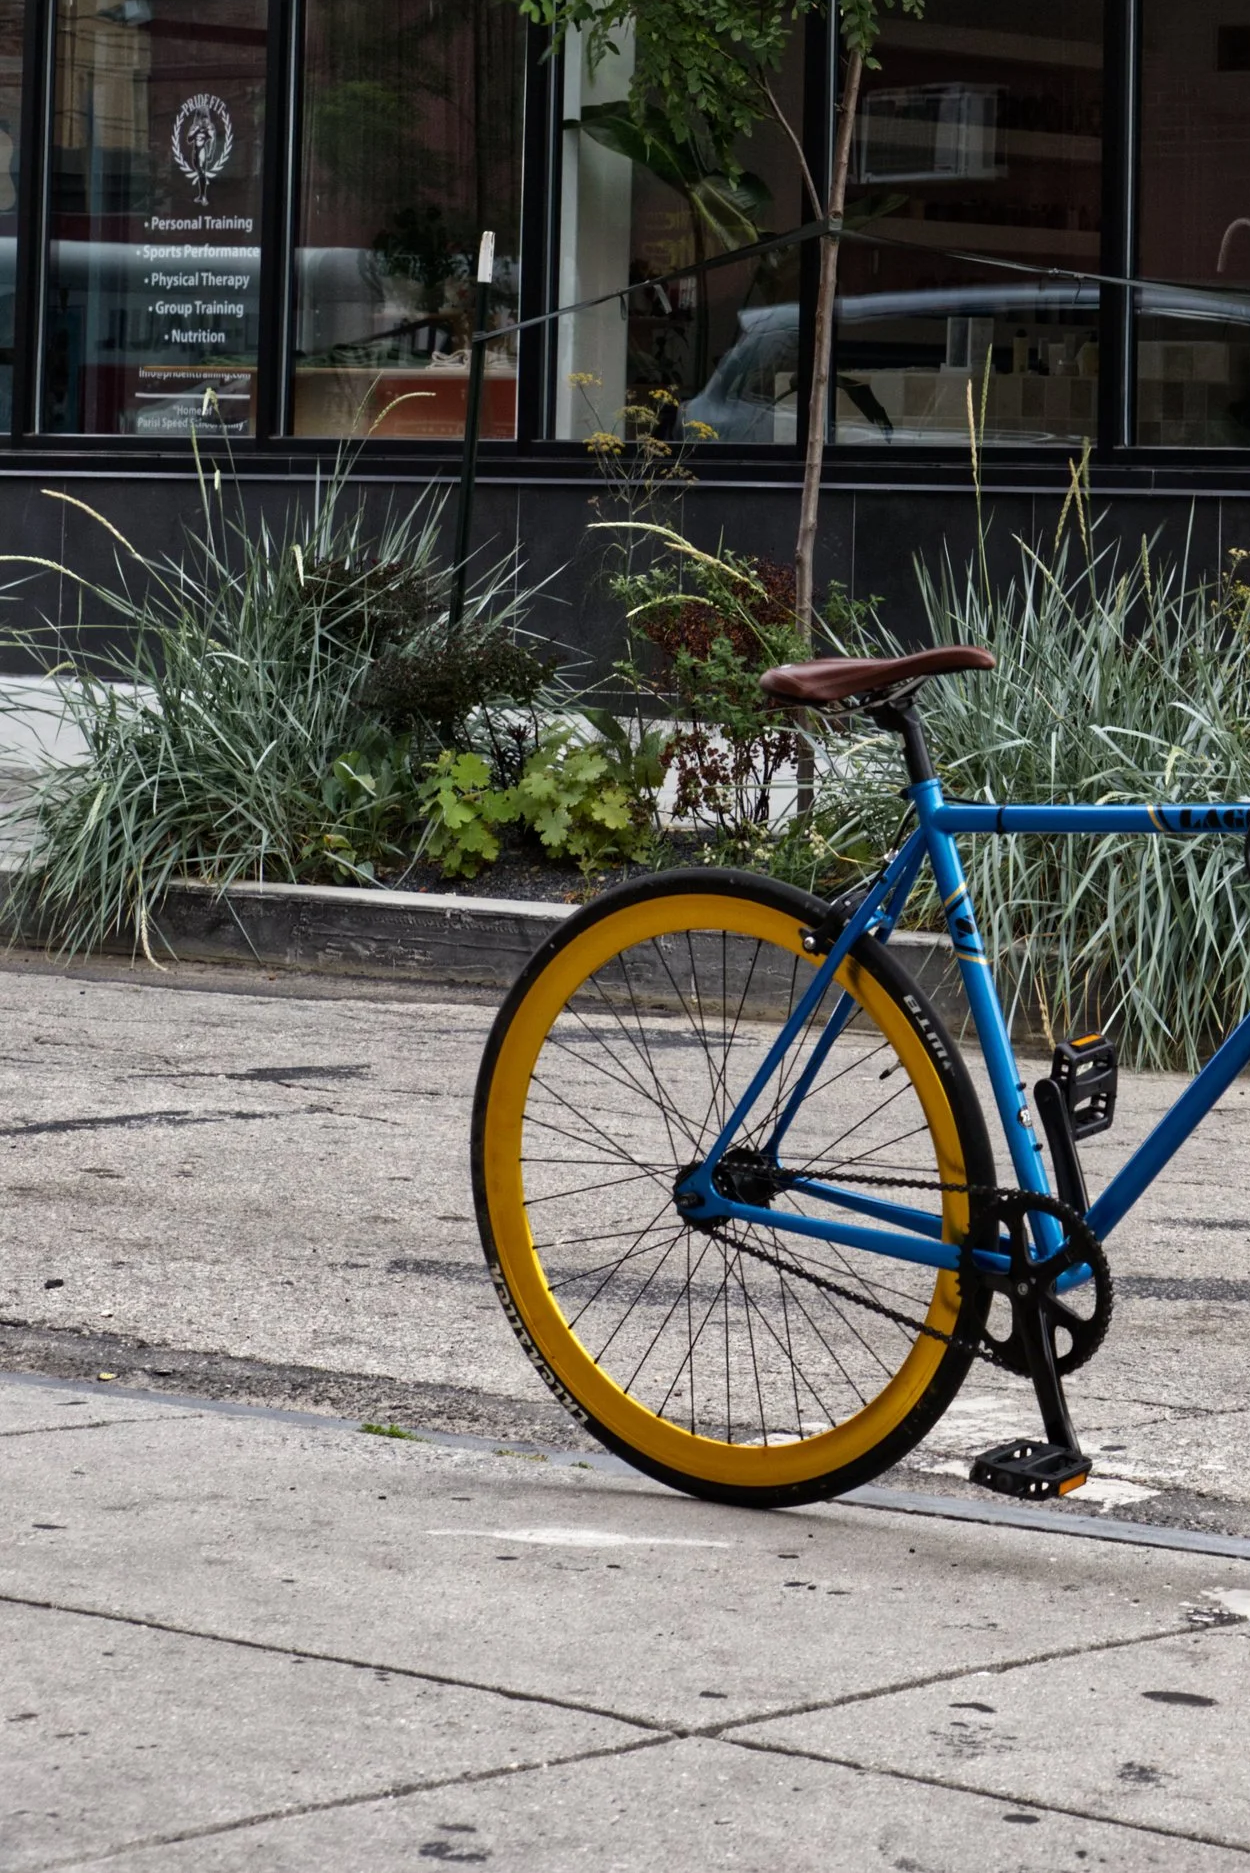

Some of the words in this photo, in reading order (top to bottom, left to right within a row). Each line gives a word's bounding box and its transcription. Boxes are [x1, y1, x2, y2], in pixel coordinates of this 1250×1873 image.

[151, 215, 202, 230] Personal
[204, 215, 253, 233] Training
[143, 244, 182, 261] Sports
[184, 243, 260, 258] Performance
[151, 272, 199, 289] Physical
[201, 272, 250, 289] Therapy
[155, 301, 192, 318] Group
[194, 300, 244, 318] Training
[171, 329, 225, 343] Nutrition
